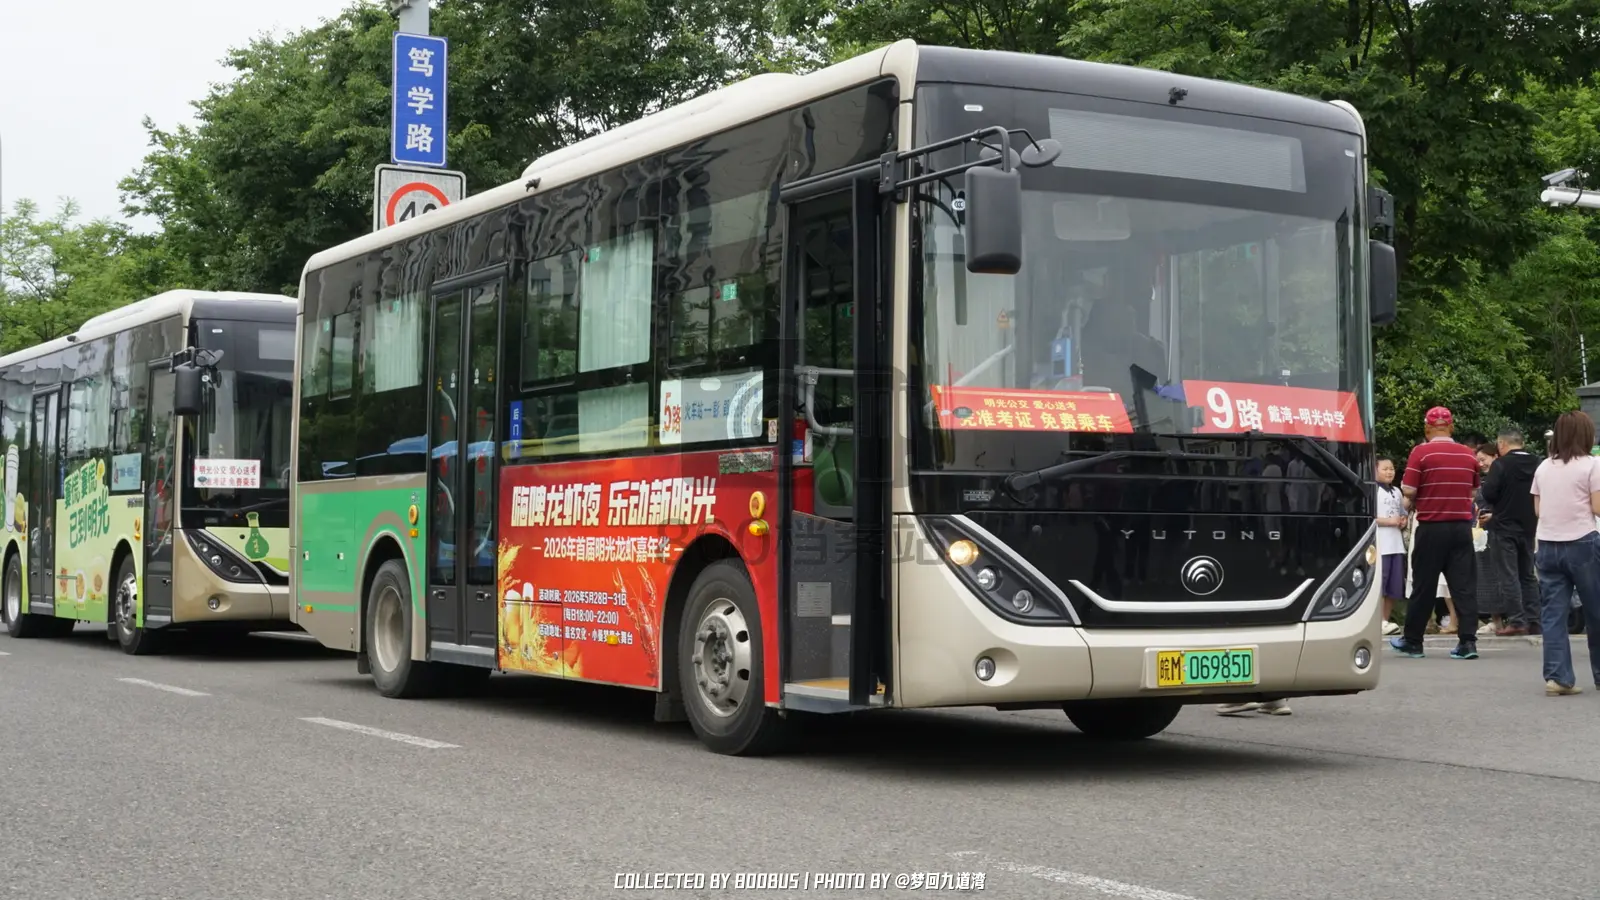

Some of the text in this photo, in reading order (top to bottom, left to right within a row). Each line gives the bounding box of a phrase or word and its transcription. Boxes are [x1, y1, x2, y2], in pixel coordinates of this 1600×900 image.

[404, 47, 434, 152] 笃学路
[984, 398, 1077, 411] 明光公交 爱心送考
[1206, 387, 1263, 430] 9路
[1040, 411, 1115, 431] 免费乘车
[511, 475, 716, 527] 嗨啤龙虾夜 乐动新明光
[1120, 529, 1281, 540] YUTONG
[543, 535, 671, 563] 2026年首届明光龙虾嘉年华
[1160, 653, 1251, 681] 皖M 06985D
